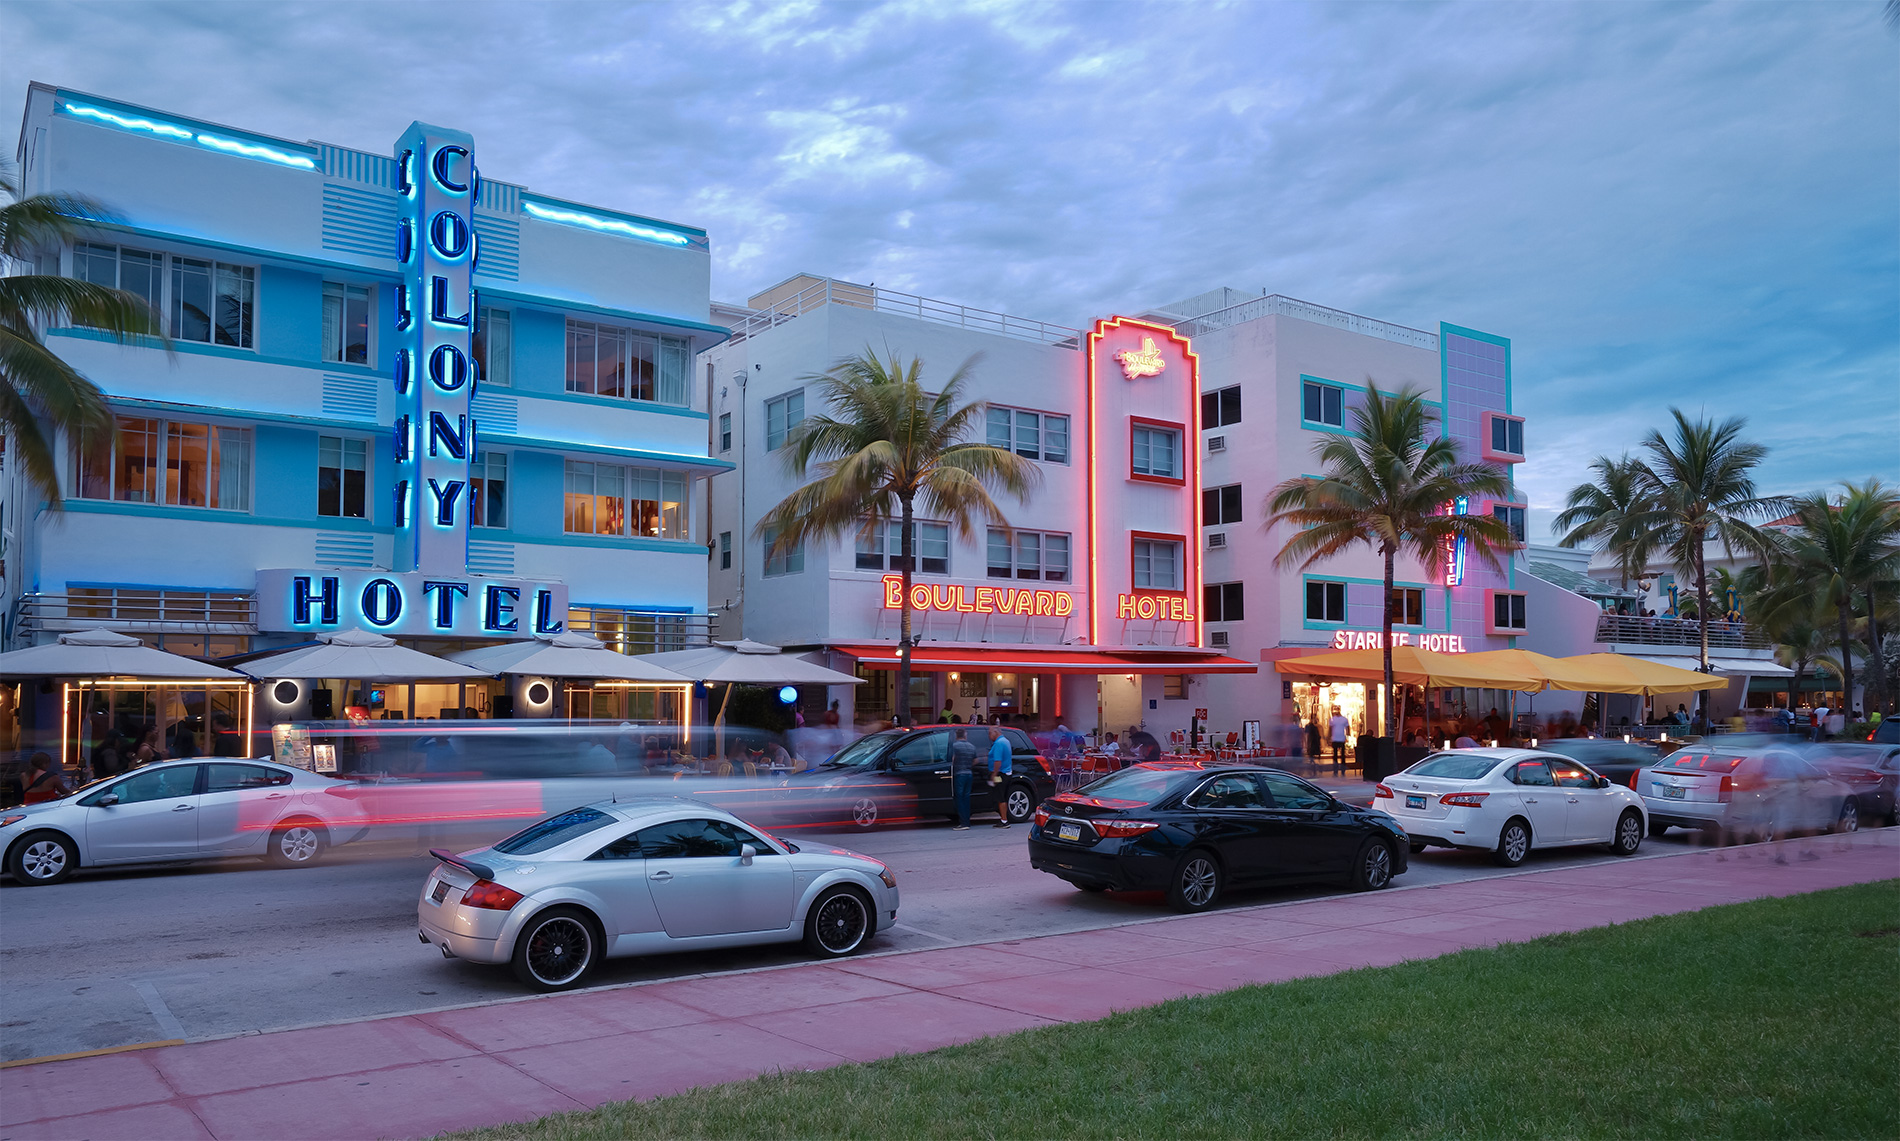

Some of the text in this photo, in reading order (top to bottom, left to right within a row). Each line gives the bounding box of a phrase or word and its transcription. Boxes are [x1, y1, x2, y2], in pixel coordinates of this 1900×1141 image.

[427, 144, 470, 526] COLONY
[293, 576, 563, 633] HOTEL
[881, 574, 1195, 621] BOULEVARD HOTEL
[1335, 630, 1467, 653] STARLTE HOTEL
